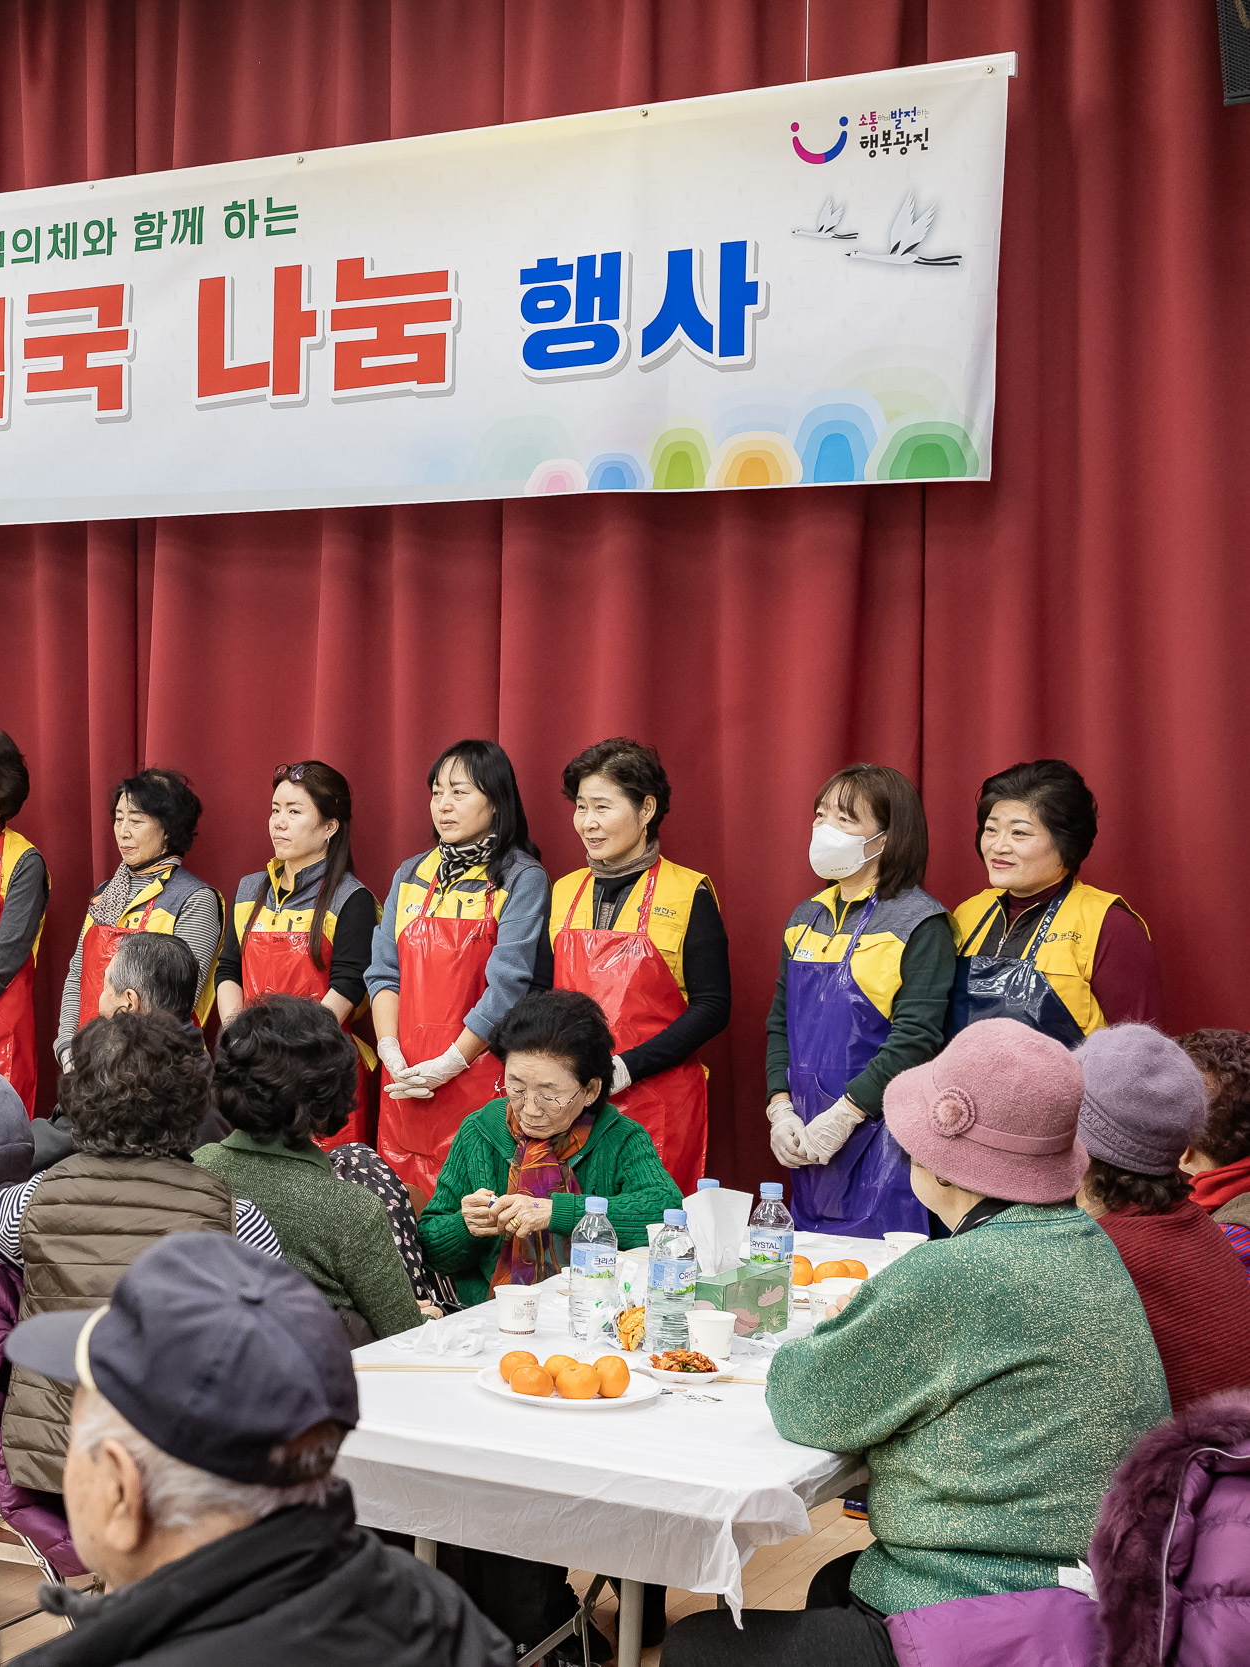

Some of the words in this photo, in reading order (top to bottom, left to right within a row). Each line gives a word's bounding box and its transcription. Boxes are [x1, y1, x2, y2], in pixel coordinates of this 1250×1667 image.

[859, 127, 929, 158] 행복광진
[133, 206, 205, 252] 함께
[223, 197, 299, 239] 하는
[197, 256, 452, 397] 나눔
[519, 240, 759, 371] 행사
[653, 906, 677, 916] 광진구
